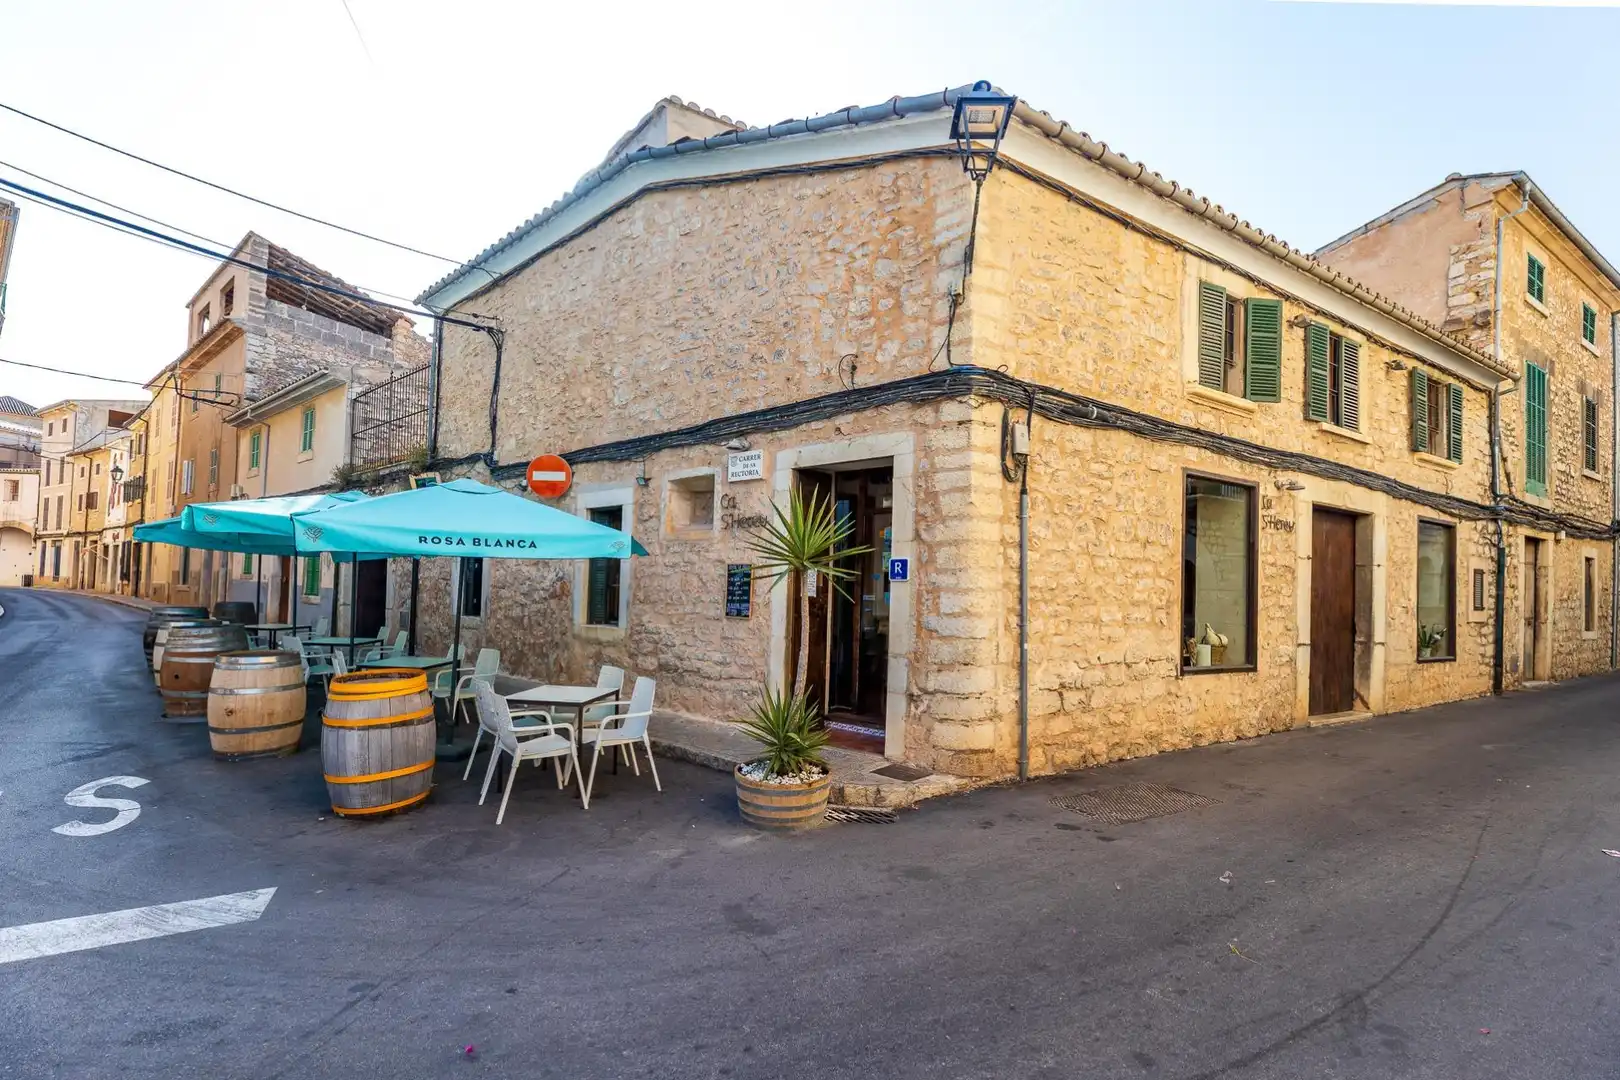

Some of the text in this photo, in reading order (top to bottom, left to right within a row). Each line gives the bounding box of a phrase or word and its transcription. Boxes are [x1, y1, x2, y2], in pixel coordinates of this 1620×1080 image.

[738, 453, 762, 463] CARRER
[730, 469, 759, 478] RECTORIA
[418, 535, 537, 549] ROSA BLANCA
[894, 561, 903, 574] R
